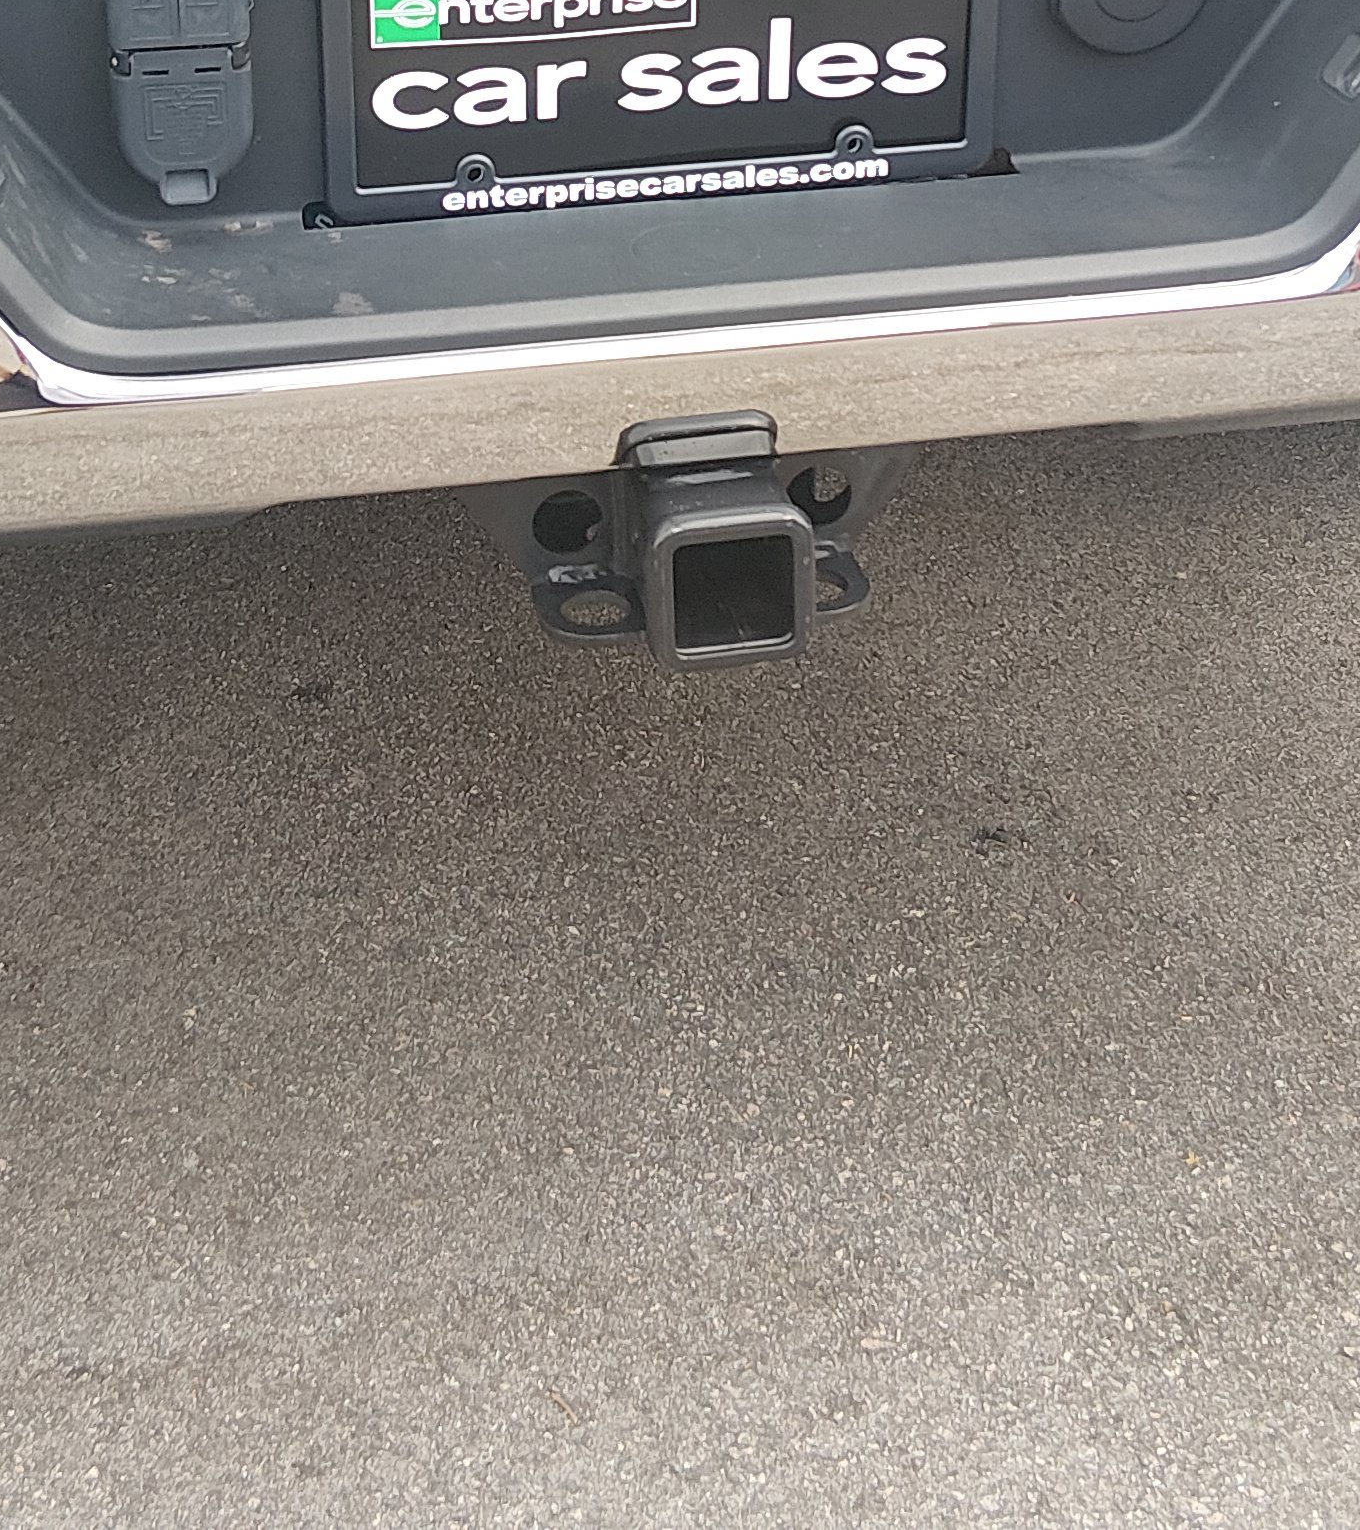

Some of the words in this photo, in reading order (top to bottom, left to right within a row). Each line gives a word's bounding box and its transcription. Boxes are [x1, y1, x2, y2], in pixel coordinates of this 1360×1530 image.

[371, 60, 588, 131] car
[616, 16, 949, 113] sales
[441, 157, 890, 212] enterprisecarsales.com
